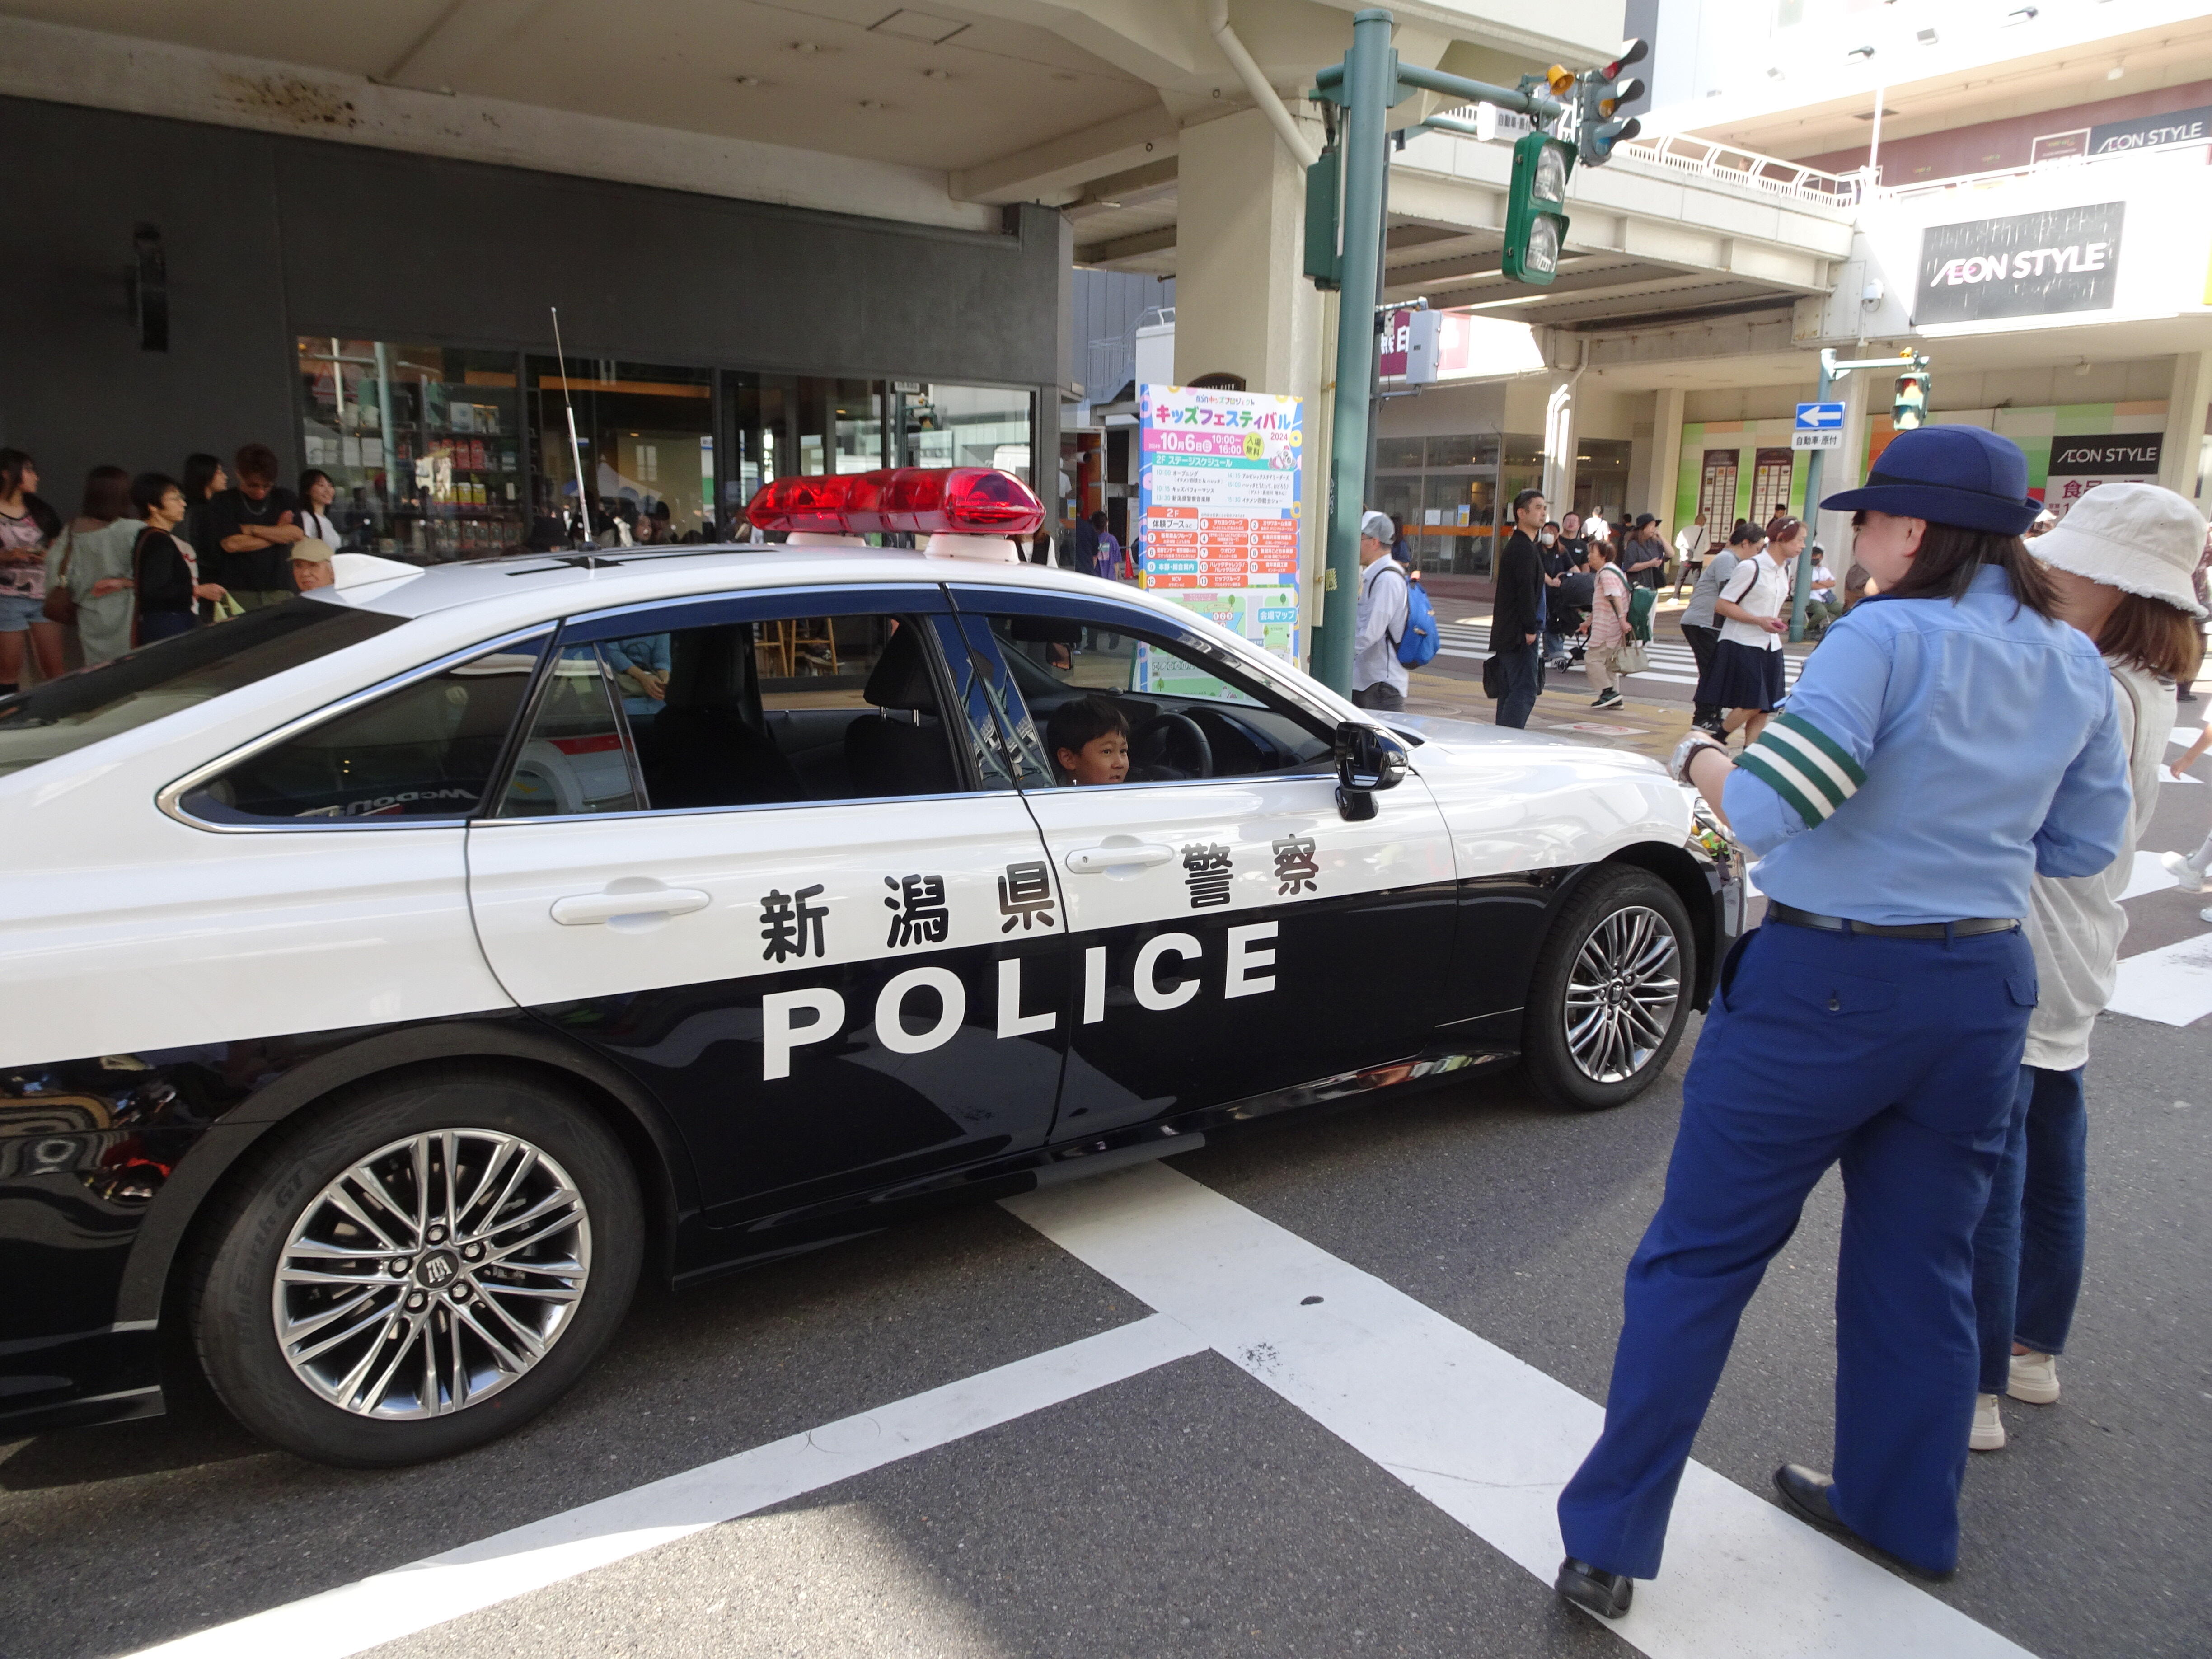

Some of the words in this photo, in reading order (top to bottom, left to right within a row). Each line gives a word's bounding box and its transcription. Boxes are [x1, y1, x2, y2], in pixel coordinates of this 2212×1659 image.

[2147, 121, 2203, 145] STYLE
[2012, 242, 2108, 279] STYLE
[1156, 404, 1291, 430] キッズフェスティバル
[1270, 432, 1288, 441] 2024
[1796, 435, 1837, 446] 自動車・原付
[1218, 444, 1242, 455] 16:00
[2105, 447, 2158, 462] STYLE
[1156, 455, 1166, 464] 2F
[1168, 456, 1233, 467] ステージスケジュール
[1166, 508, 1180, 518] 2F
[1260, 610, 1295, 620] 会場マップ
[762, 920, 1279, 1082] POLICE
